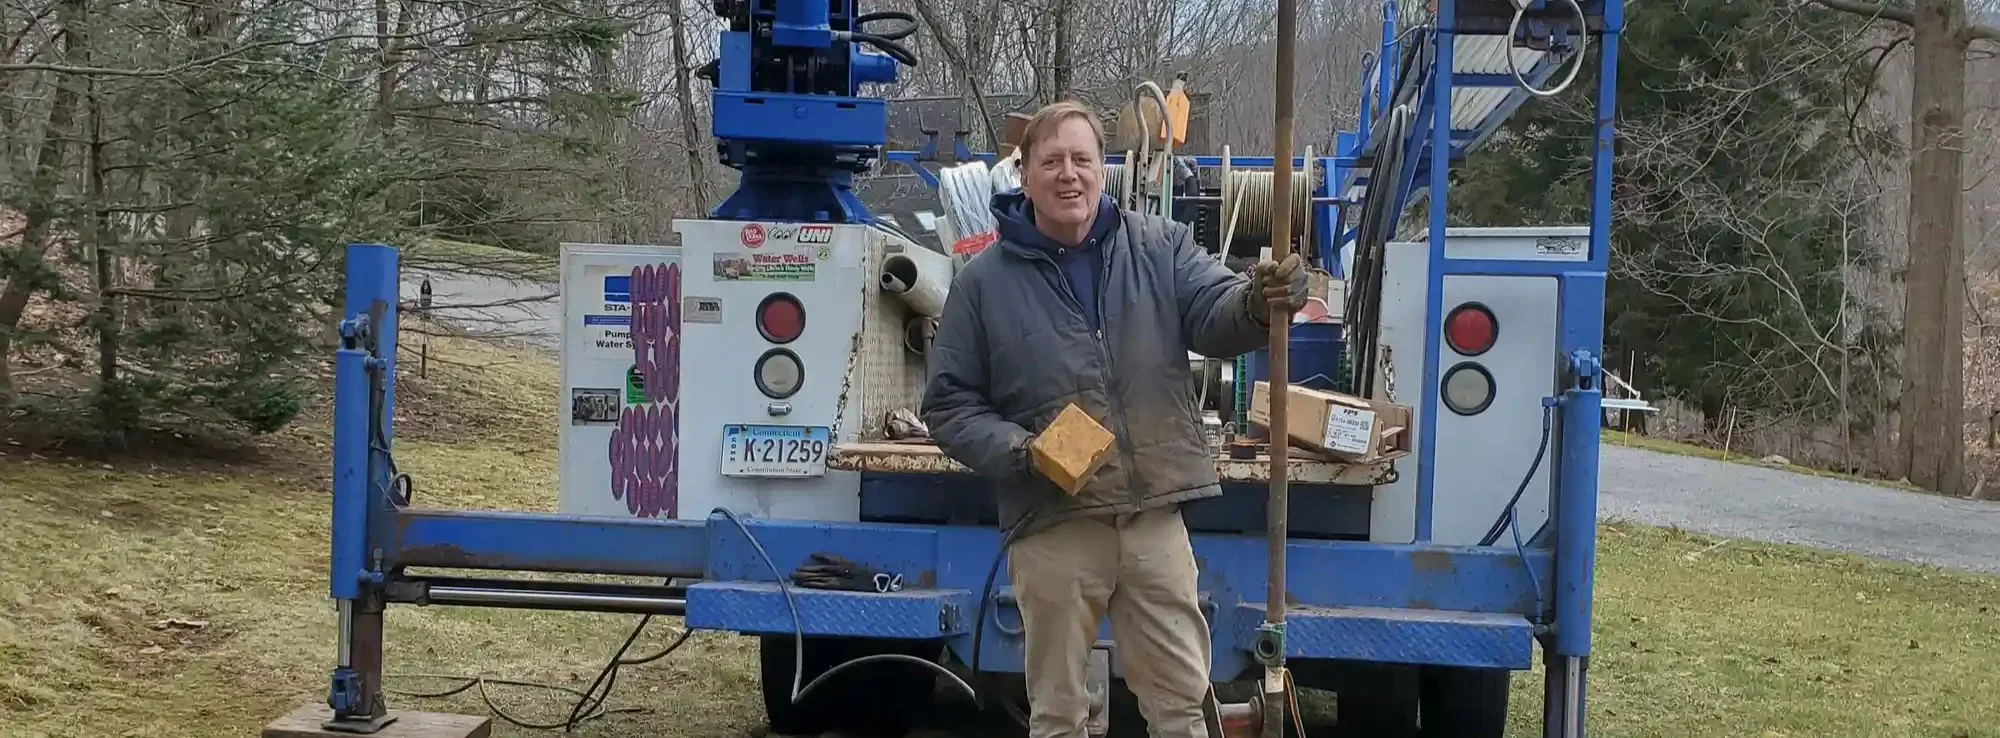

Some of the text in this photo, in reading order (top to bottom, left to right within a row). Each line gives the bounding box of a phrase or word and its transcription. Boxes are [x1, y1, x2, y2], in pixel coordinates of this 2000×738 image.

[753, 254, 809, 263] Water Wells
[604, 304, 631, 312] STA-
[605, 330, 633, 340] Pump
[596, 340, 623, 348] Water
[752, 428, 801, 437] Connecticut
